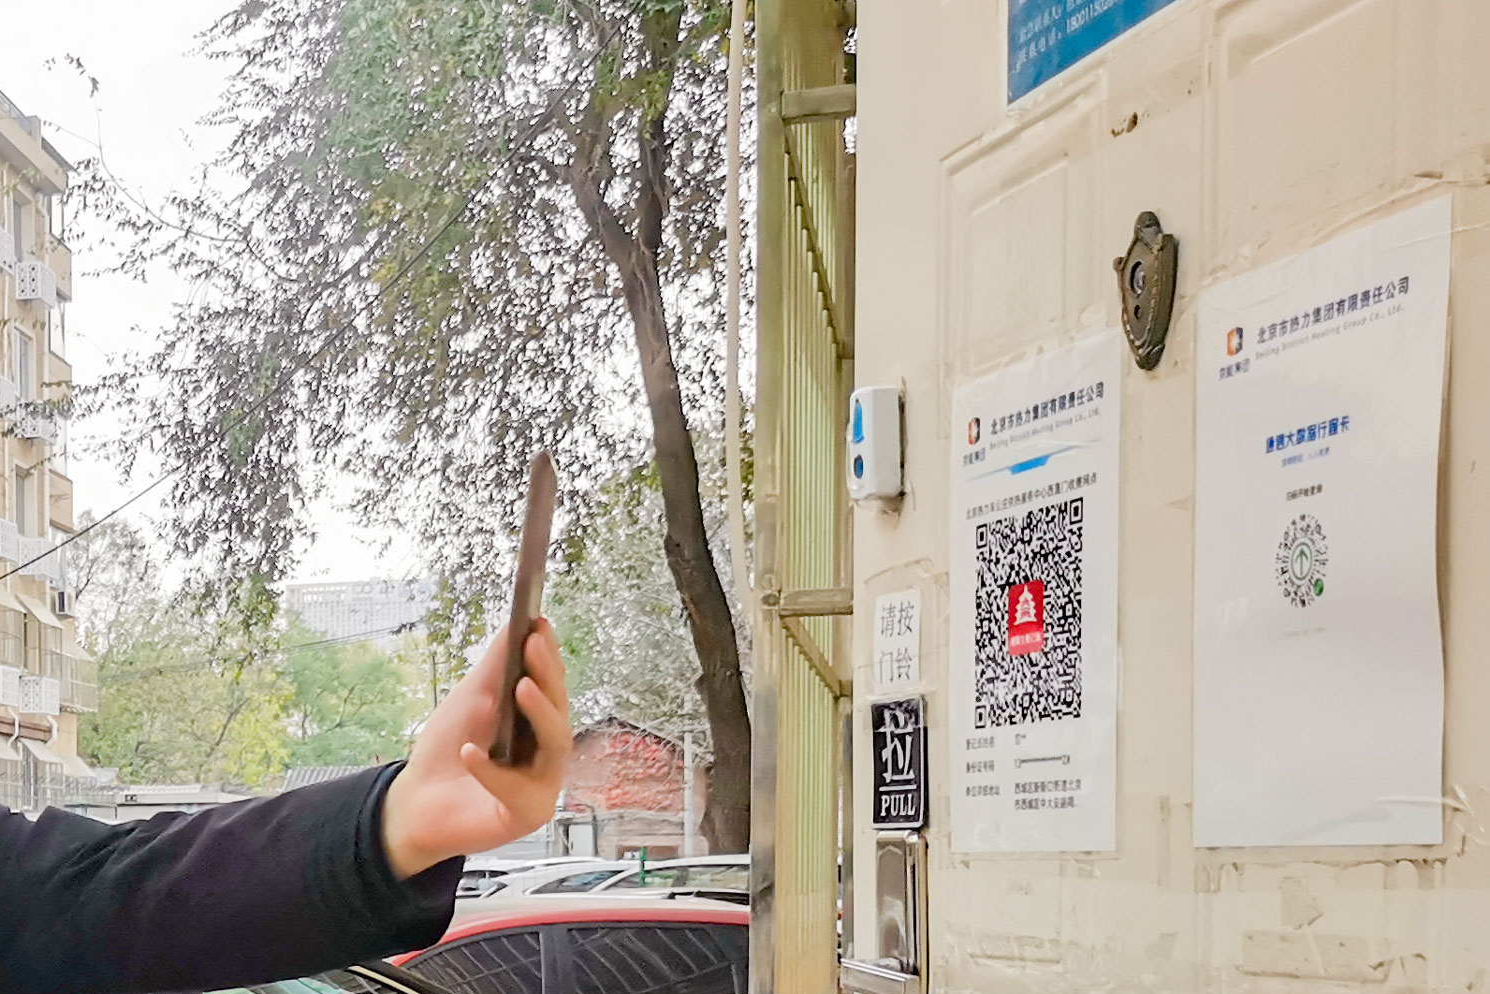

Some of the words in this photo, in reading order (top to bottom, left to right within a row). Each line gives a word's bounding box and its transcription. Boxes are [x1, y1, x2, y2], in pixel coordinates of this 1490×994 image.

[1257, 276, 1409, 344] 北京市热力集团有限责任公司
[990, 381, 1104, 435] 北京市热力集团有限责任公司
[881, 602, 915, 638] 请按
[879, 647, 912, 684] 门铃
[875, 707, 915, 784] 拉
[880, 793, 916, 817] PULL
